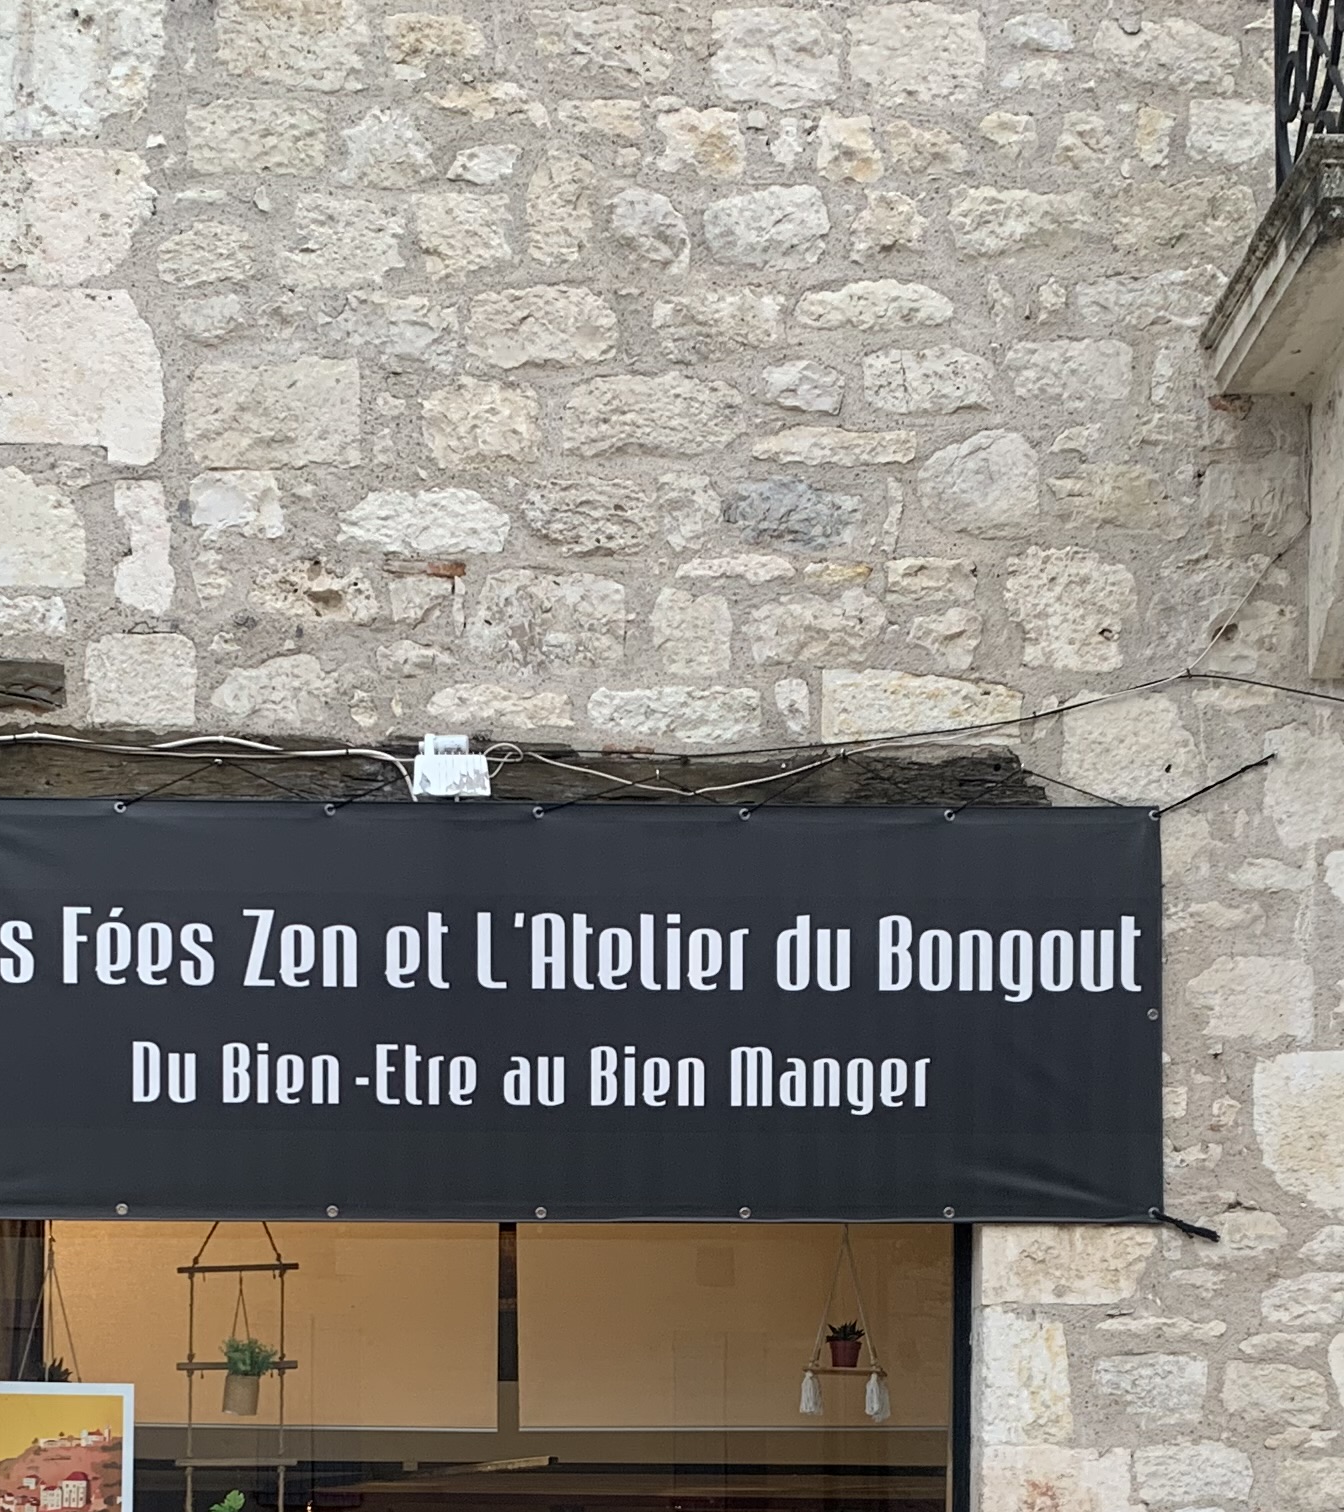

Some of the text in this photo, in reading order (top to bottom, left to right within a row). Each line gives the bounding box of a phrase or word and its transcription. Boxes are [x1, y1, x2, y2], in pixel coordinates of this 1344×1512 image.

[63, 907, 214, 985] Fées
[243, 909, 357, 987] Zen
[385, 912, 449, 988] et
[478, 912, 749, 990] L'Atelier
[777, 915, 850, 991] du
[879, 915, 1141, 1002] Bongout
[133, 1041, 930, 1115] Du Bien -Etre au Bien Manger
